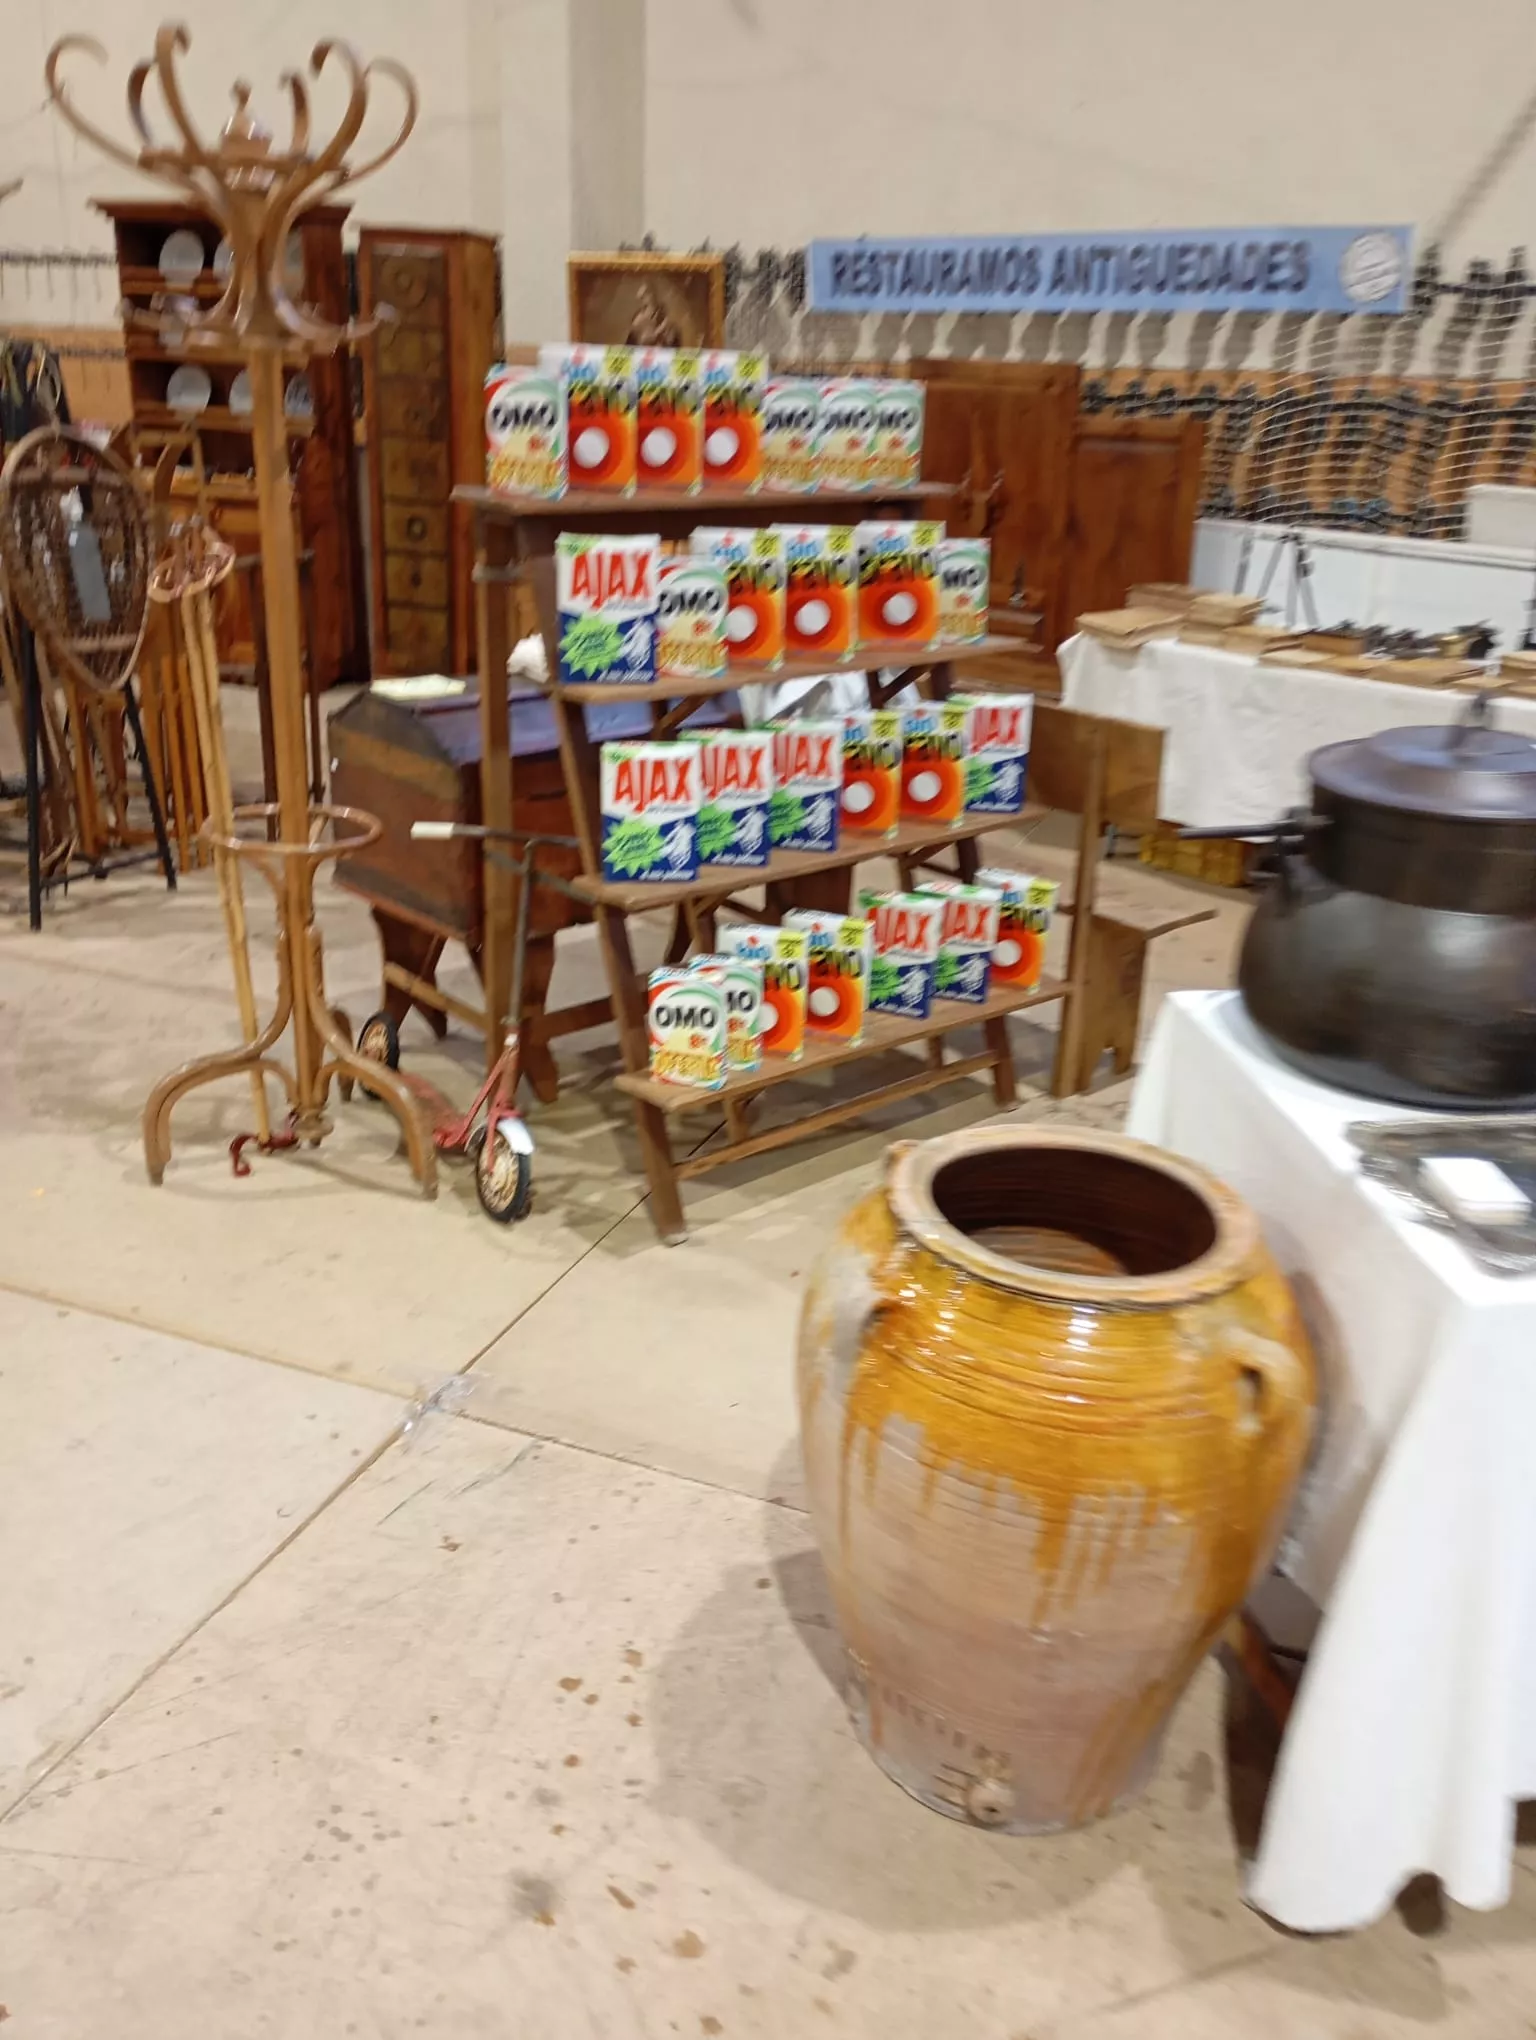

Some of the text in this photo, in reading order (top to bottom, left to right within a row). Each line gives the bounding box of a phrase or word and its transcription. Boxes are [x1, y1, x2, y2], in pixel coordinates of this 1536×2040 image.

[831, 247, 1041, 297] RESTAURAMOS
[490, 402, 557, 427] OMO
[570, 550, 652, 609] AJAX
[658, 588, 721, 614] OMO
[614, 757, 696, 813] AJAX
[655, 1006, 715, 1028] OMO
